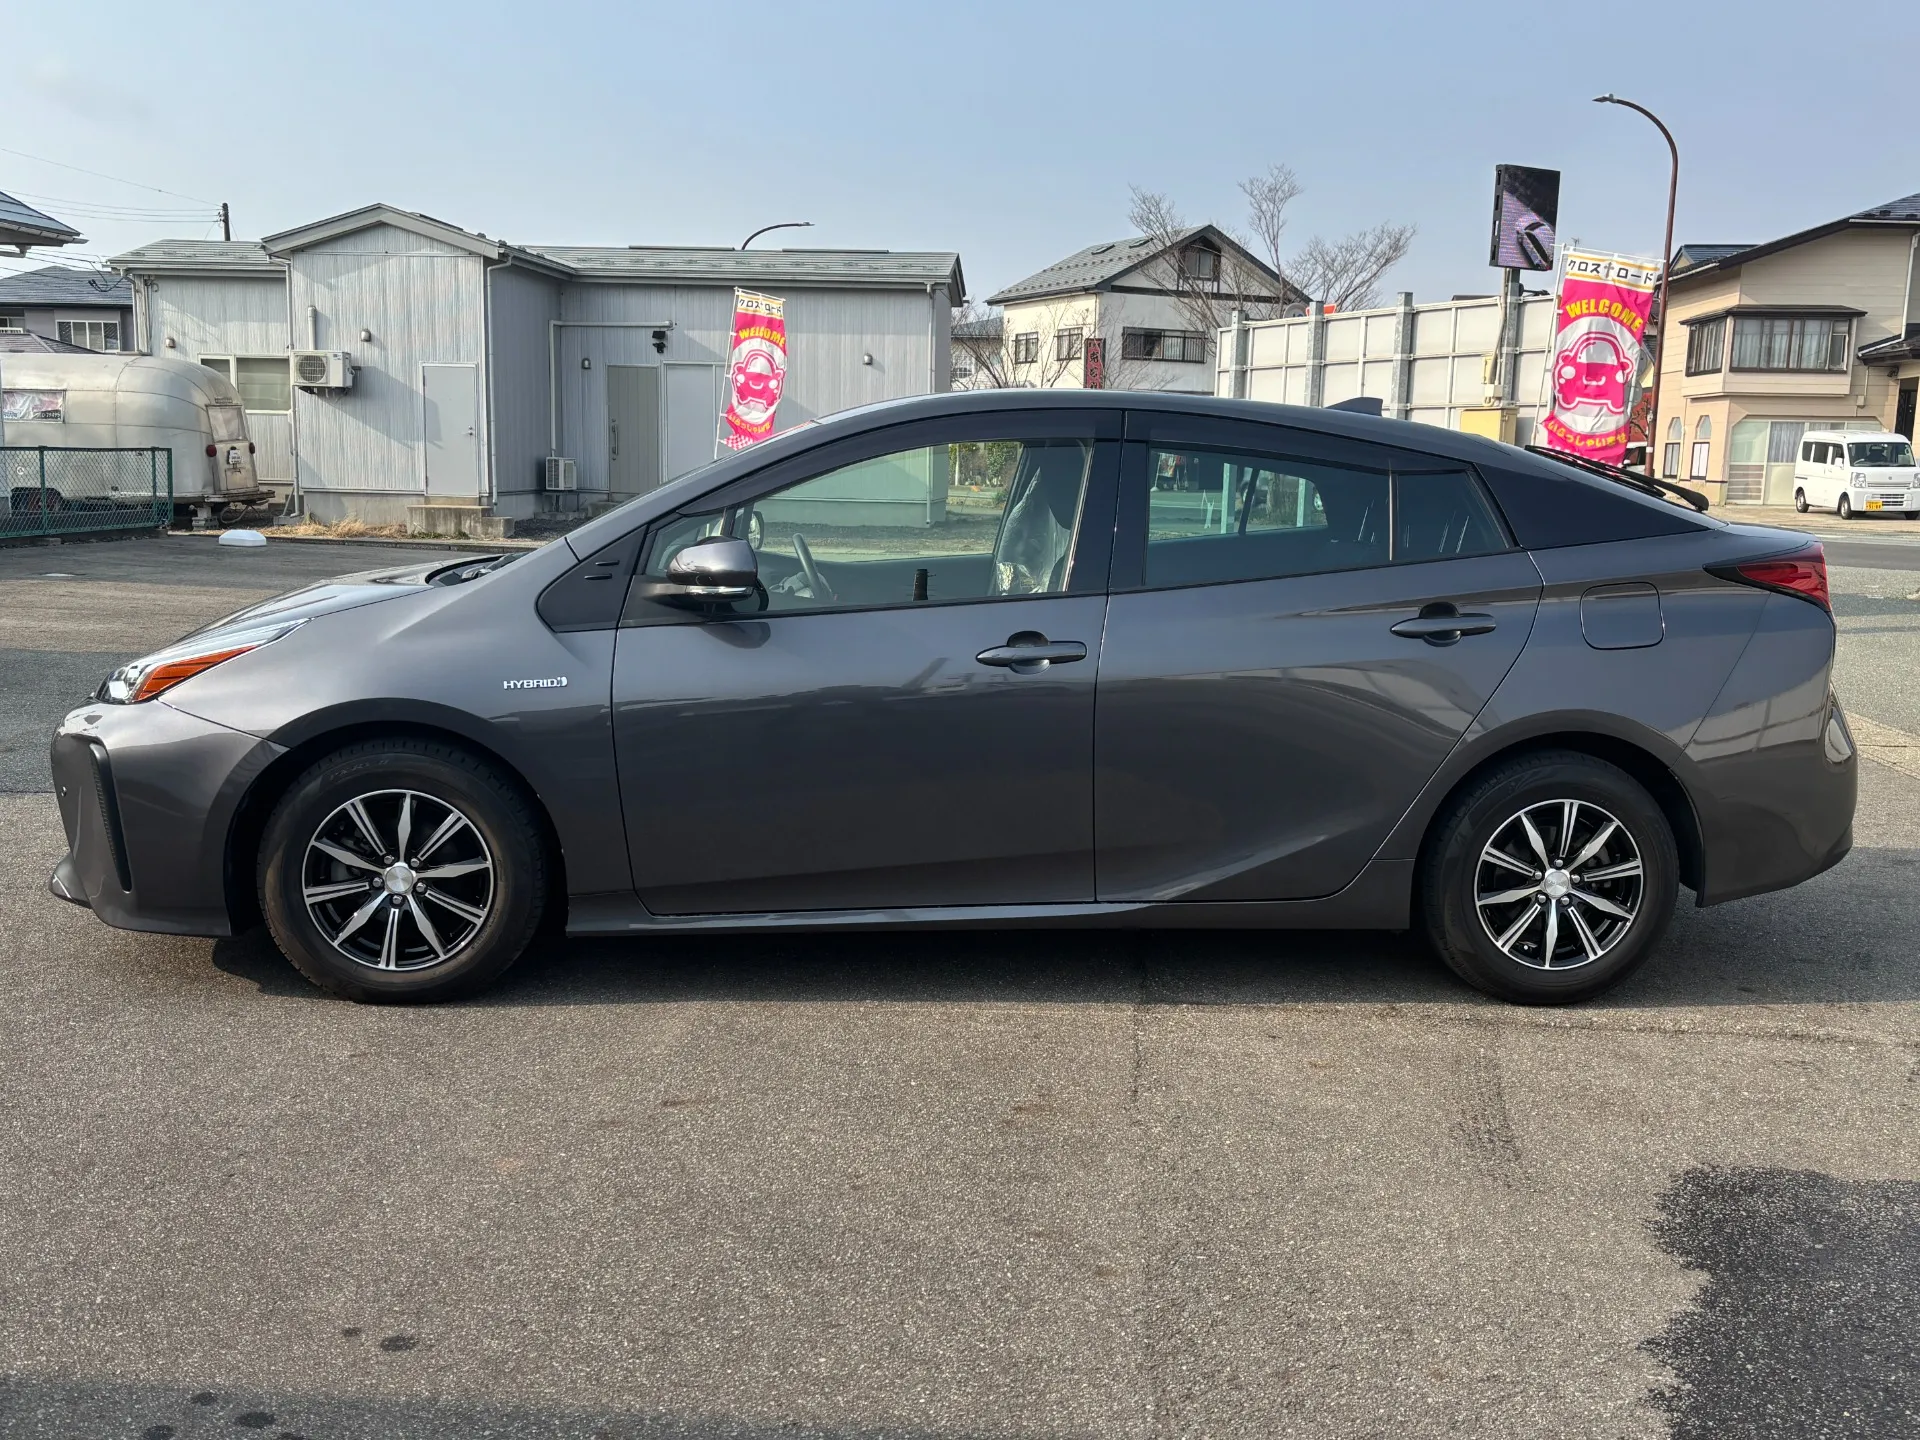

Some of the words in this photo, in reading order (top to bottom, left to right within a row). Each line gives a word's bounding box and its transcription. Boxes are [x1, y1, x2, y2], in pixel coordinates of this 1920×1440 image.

[1566, 299, 1644, 332] WELCOME
[739, 326, 786, 347] WELCOME
[503, 678, 559, 690] HYBRID
